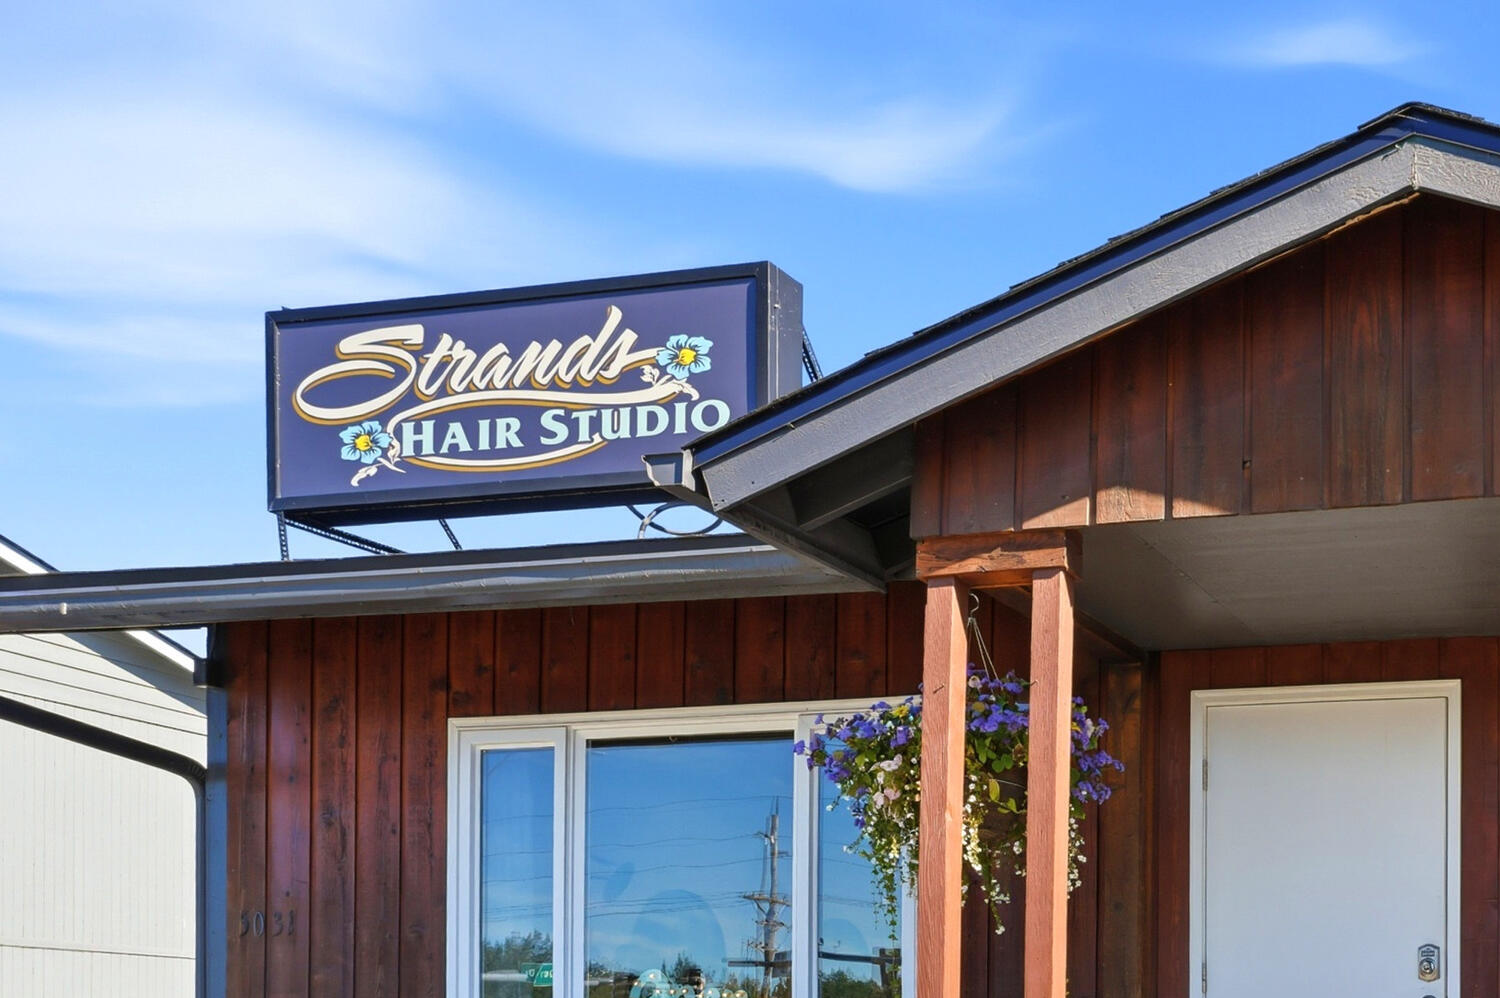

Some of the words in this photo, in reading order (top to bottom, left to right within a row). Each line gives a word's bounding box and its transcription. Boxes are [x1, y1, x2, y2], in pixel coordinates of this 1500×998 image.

[293, 305, 664, 426] Strands
[401, 416, 523, 458] HAIR
[540, 399, 731, 447] STUDIO
